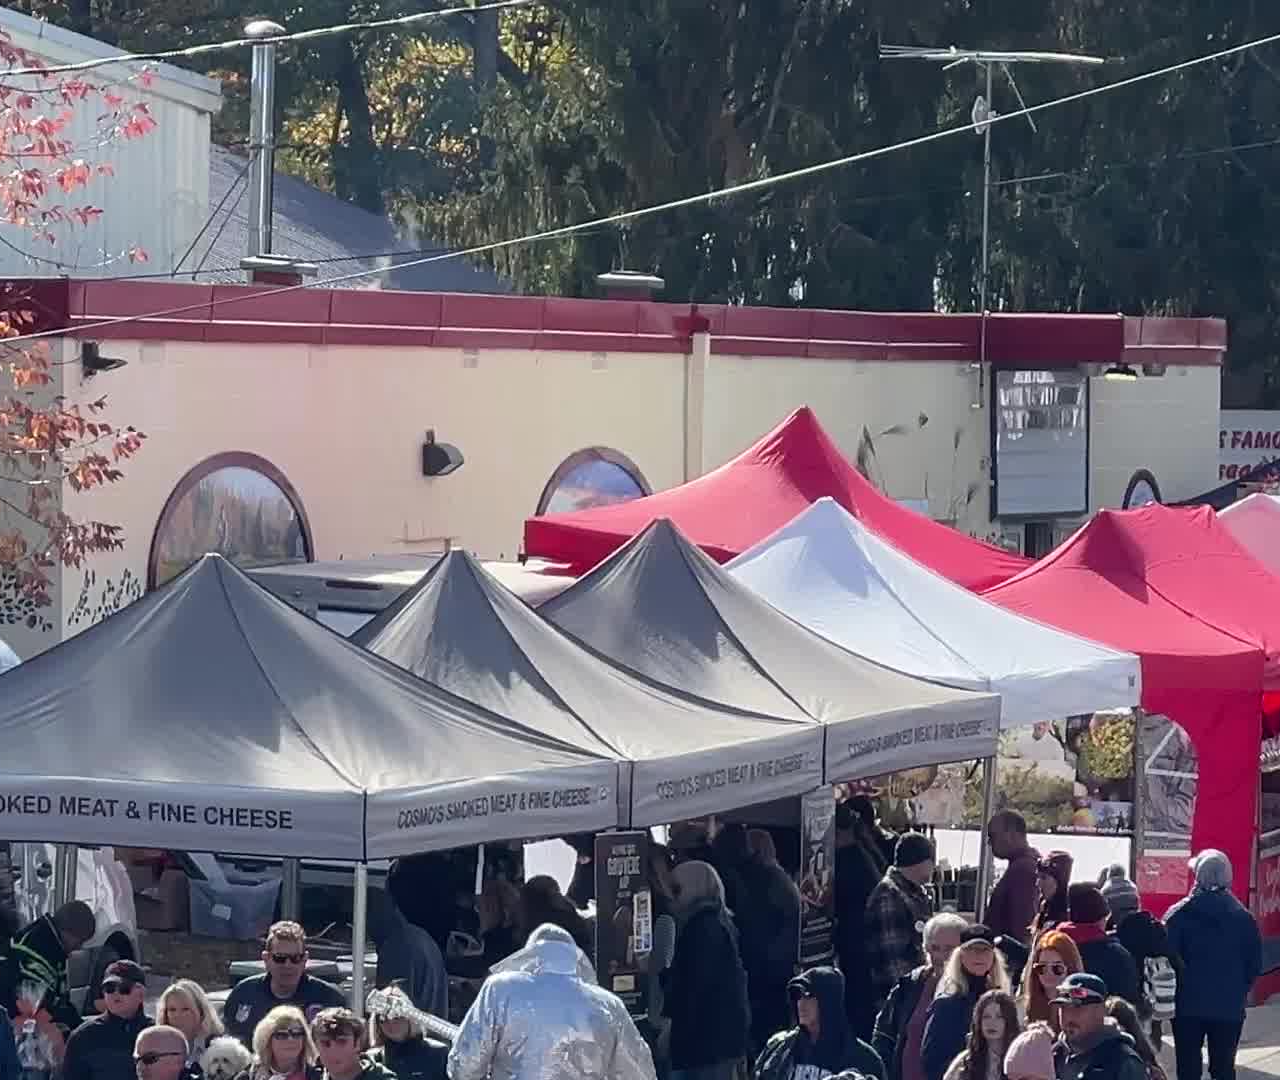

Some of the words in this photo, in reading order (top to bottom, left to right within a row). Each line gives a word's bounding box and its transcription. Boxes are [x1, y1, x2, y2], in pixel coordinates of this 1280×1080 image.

[59, 796, 118, 818] MEAT
[125, 801, 140, 819] &
[148, 802, 197, 824] FINE
[203, 806, 293, 830] CHEESE
[397, 804, 445, 830] COSMO'S
[447, 798, 488, 820] SMOKED
[490, 794, 518, 814] MEAT
[528, 792, 550, 810] FINE
[552, 786, 591, 808] CHEESE
